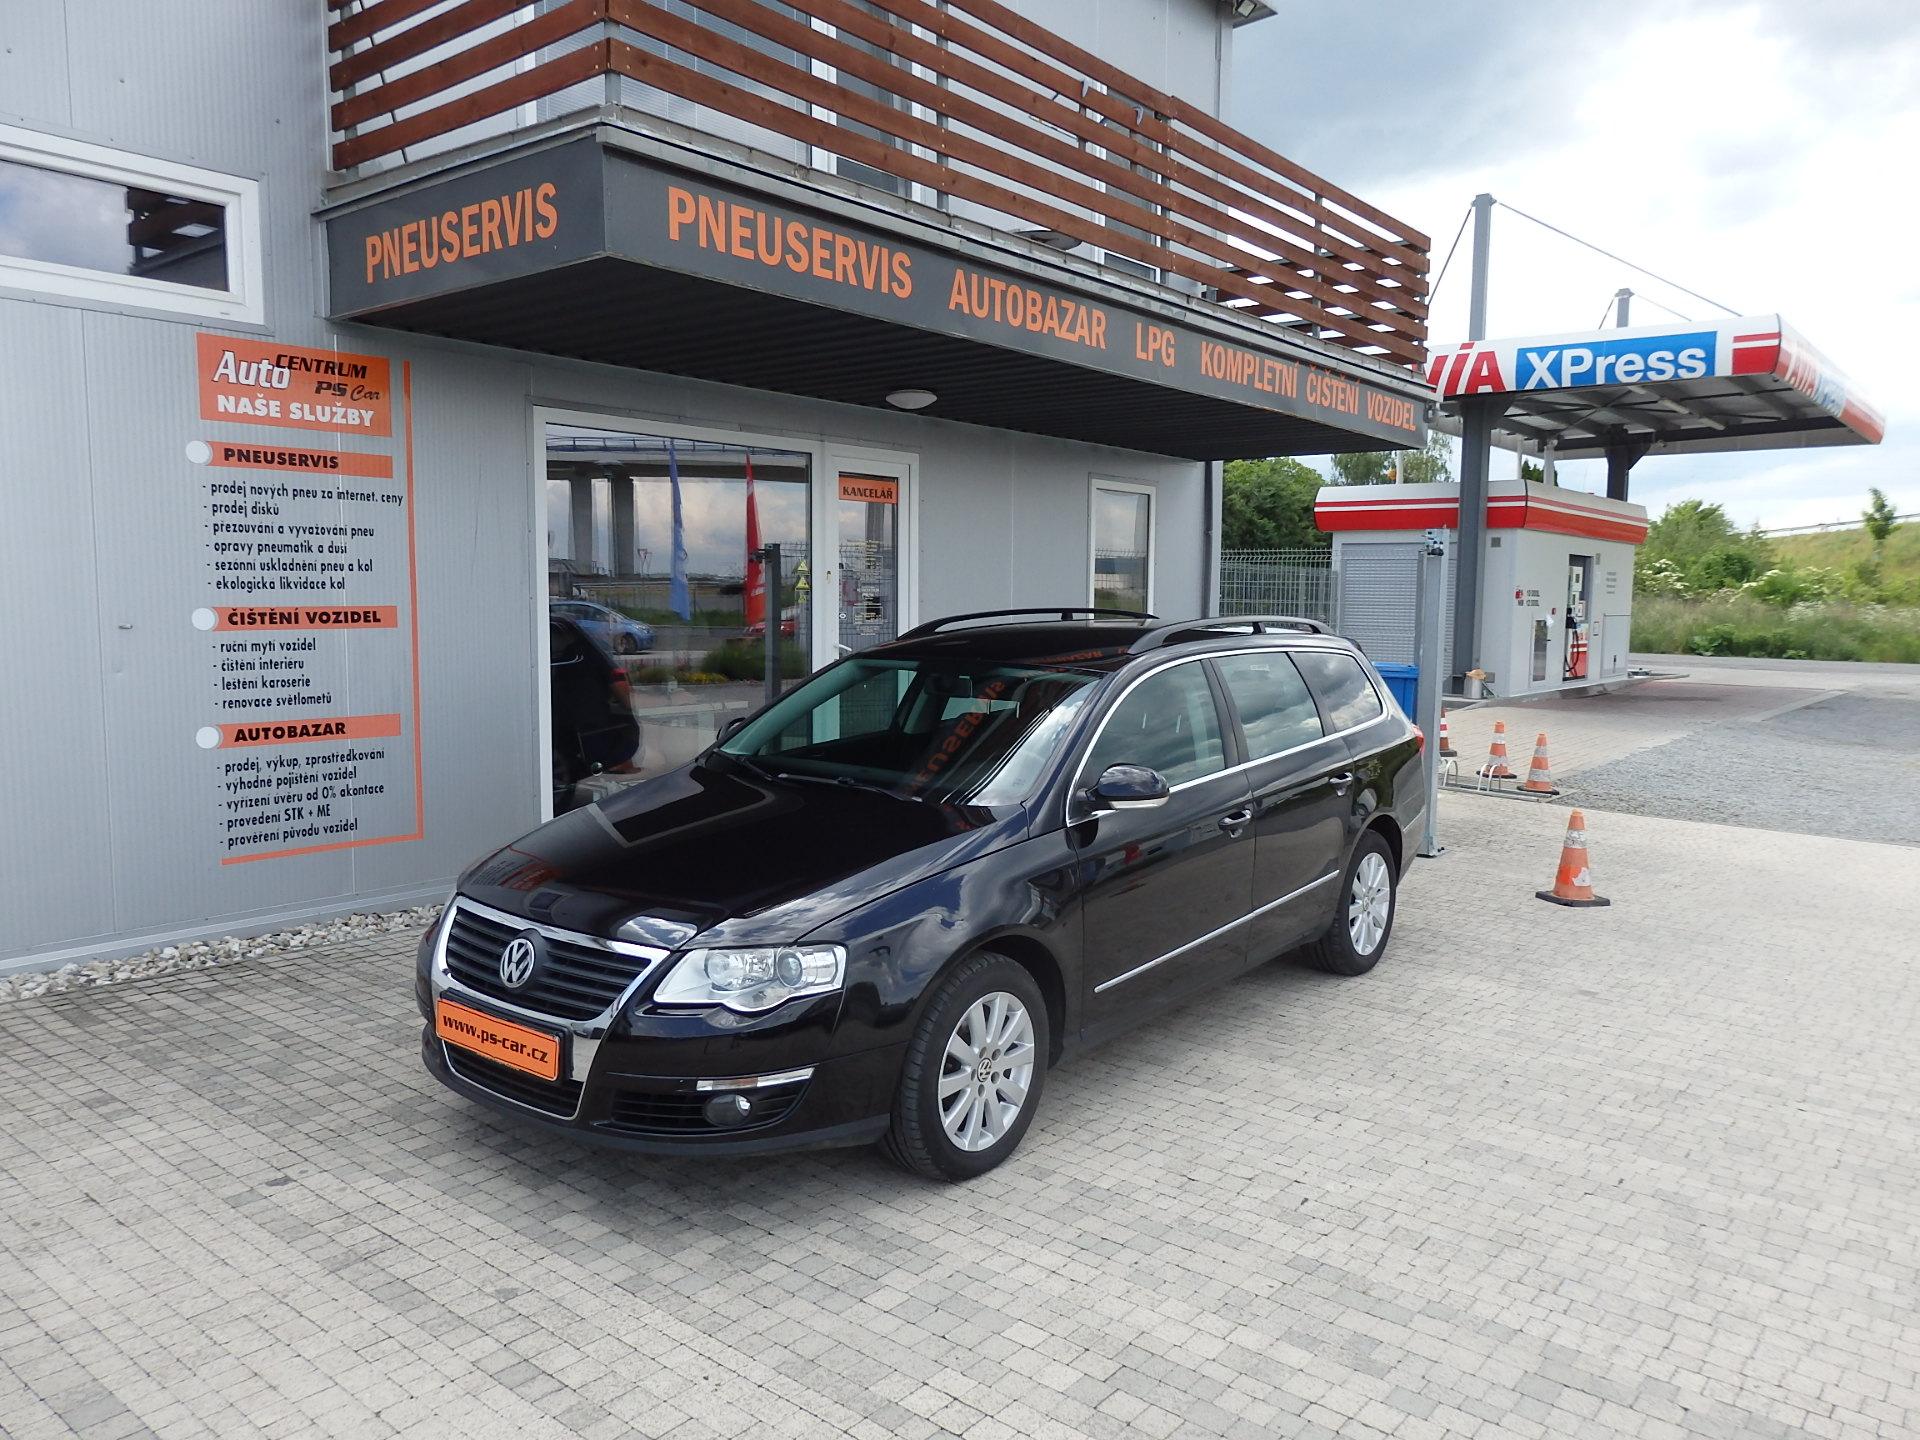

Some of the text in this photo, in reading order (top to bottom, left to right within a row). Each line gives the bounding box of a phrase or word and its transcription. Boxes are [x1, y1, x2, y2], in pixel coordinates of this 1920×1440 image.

[366, 182, 558, 284] PNEUSERVIS
[667, 185, 1416, 431] PNEUSERVIS AUTOBAZAR LPG KOMPLETNÍ ČIŠTĚNÍ VOZIDEL
[211, 350, 368, 389] Auto CENTRUM
[1522, 346, 1707, 388] XPress
[314, 380, 381, 402] PS Car
[217, 393, 375, 427] NAŠE SLUŽBY
[223, 447, 339, 469] PNEUSERVIS
[211, 480, 247, 499] prodej
[250, 481, 288, 500] nových
[292, 487, 318, 501] pneu
[321, 488, 333, 499] za
[381, 493, 403, 506] ceny
[212, 500, 279, 518] prodej disků
[213, 522, 375, 539] přezouvání a vyvažování pneu
[214, 542, 254, 556] opravy
[257, 539, 314, 556] pneumatik
[317, 543, 324, 553] a
[215, 558, 373, 575] sezónní uskladnění pneu a kol
[216, 574, 345, 593] ekologická likvidace kol
[227, 607, 381, 626] ČIŠTĚNÍ VOZIDEL
[220, 638, 248, 653] ruční
[279, 637, 316, 652] vozidel
[221, 655, 305, 672] čištění interiéru
[222, 673, 311, 691] leštění karoserie
[222, 691, 332, 709] renovace světlometů
[234, 722, 346, 742] AUTOBAZAR
[305, 749, 385, 768] zprostředkování
[225, 766, 357, 794] výhodné pojištění vozidel
[226, 782, 385, 812] vyřízení úvěru od 0% akontace
[227, 812, 281, 832] provedení
[284, 806, 304, 822] STK
[317, 803, 331, 818] ME
[228, 818, 358, 850] prověření původu vozidel
[442, 1015, 548, 1064] www.ps-car.cz
